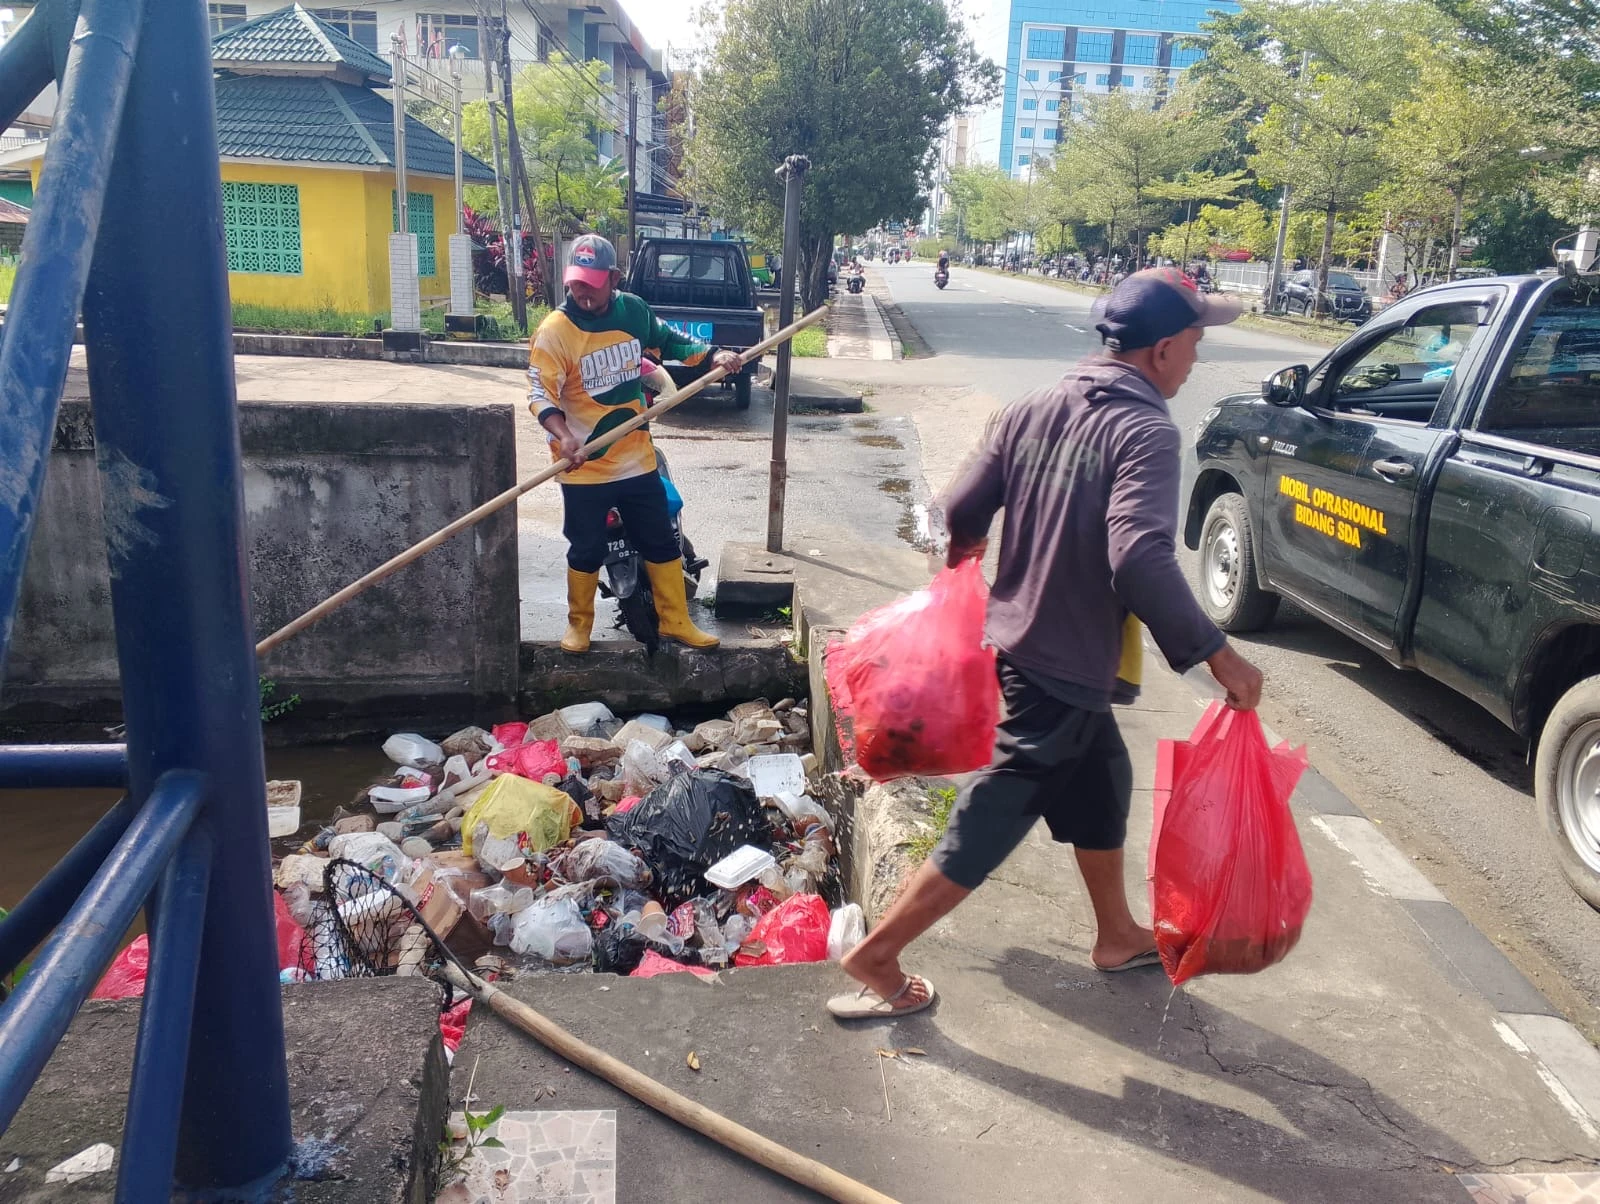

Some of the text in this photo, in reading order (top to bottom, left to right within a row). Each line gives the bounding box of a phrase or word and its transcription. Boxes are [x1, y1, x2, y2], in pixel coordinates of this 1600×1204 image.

[1280, 475, 1387, 535] MOBIL OPRASIONAL
[1295, 503, 1361, 548] BIDANG SDA
